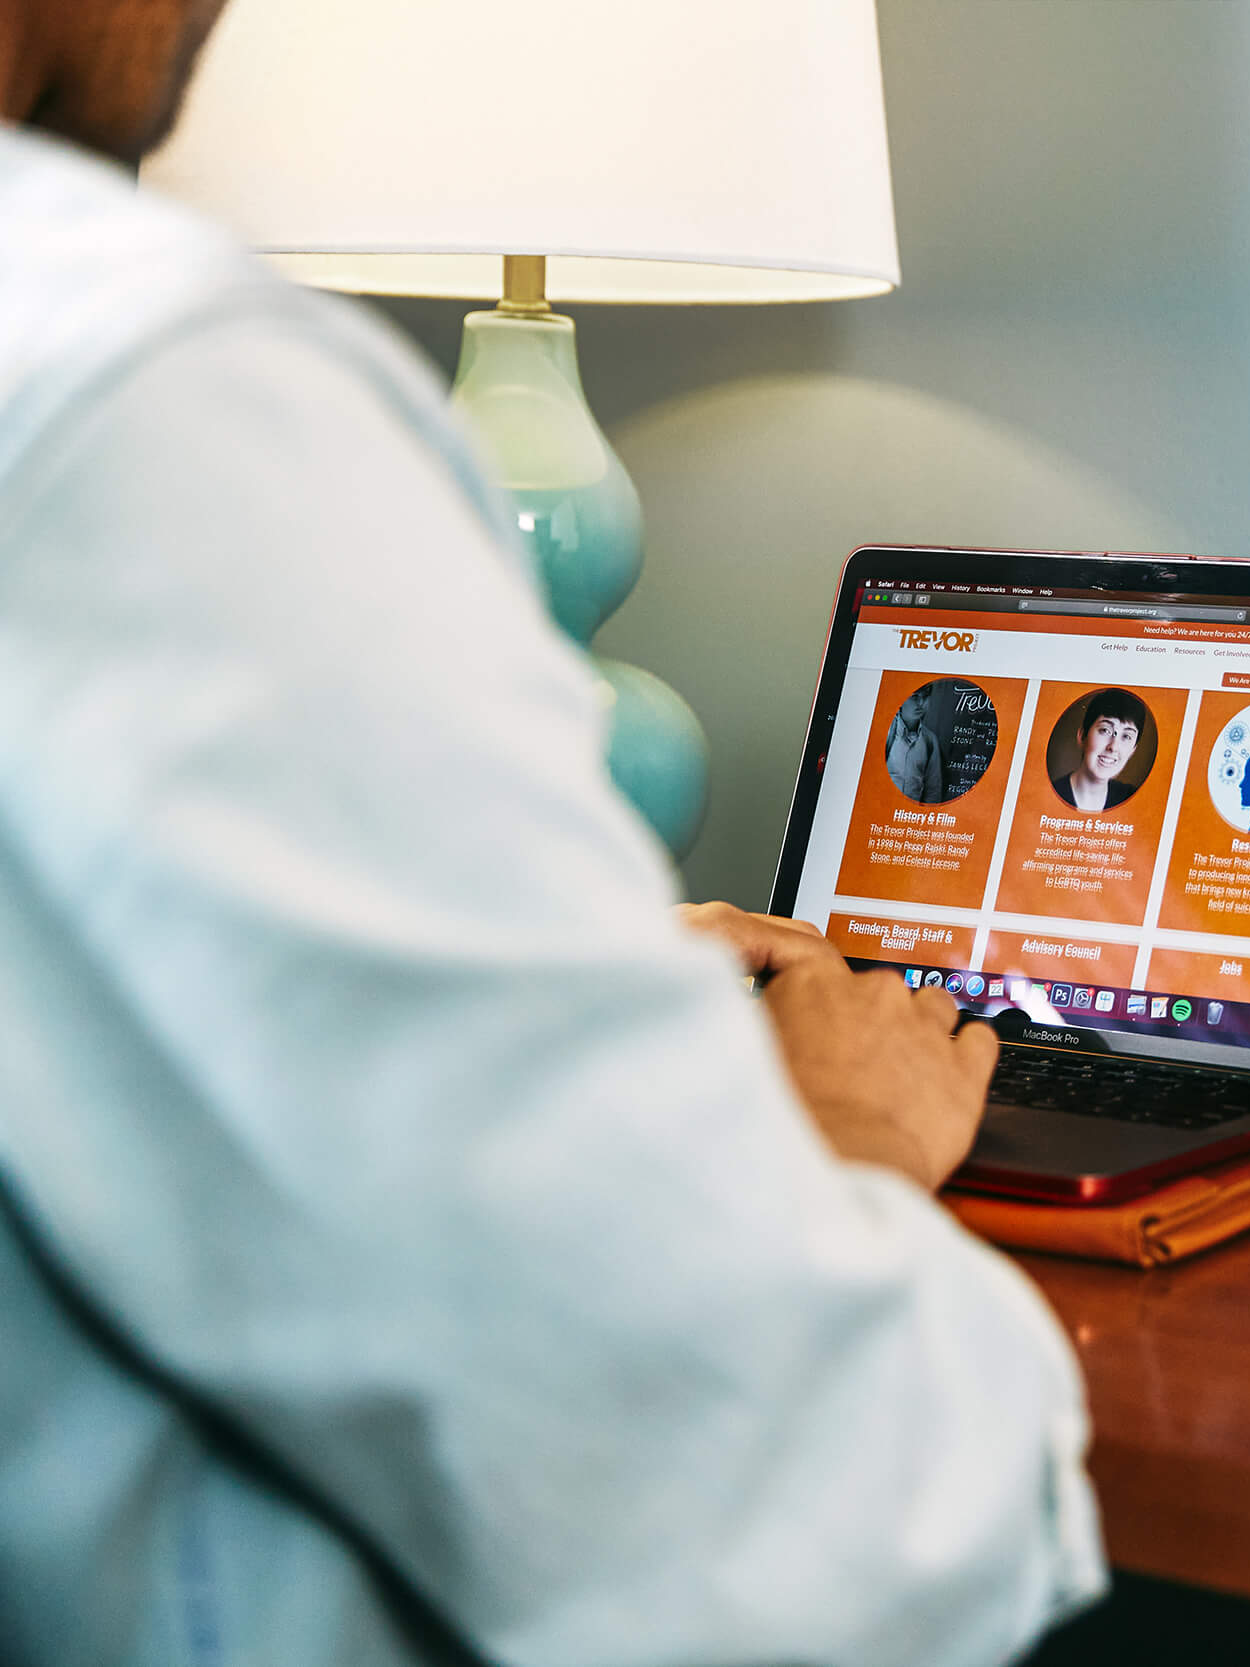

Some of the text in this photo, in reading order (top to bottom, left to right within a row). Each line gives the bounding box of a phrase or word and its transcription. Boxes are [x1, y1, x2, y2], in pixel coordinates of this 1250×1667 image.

[952, 584, 970, 593] History
[977, 586, 1006, 594] Bookmarks
[1012, 587, 1033, 595] Window
[1040, 588, 1053, 596] Help
[1143, 626, 1160, 634] Need
[1160, 626, 1177, 636] help?
[1178, 628, 1188, 636] We
[1199, 629, 1214, 637] here
[1215, 630, 1224, 638] for
[899, 629, 974, 652] TREVOR
[1101, 643, 1128, 652] Get Help
[1135, 645, 1166, 653] Education
[1174, 647, 1206, 656] Resources
[1213, 649, 1225, 657] Get
[893, 809, 956, 827] History & Film
[1040, 814, 1134, 836] Programs & Services
[870, 823, 975, 844] The Trevor Project was founded
[1040, 832, 1127, 851] The Trevor Project offers
[868, 837, 875, 848] in
[876, 838, 894, 851] 1998
[894, 839, 903, 851] by
[947, 844, 969, 858] Randy
[1034, 847, 1072, 860] accredited
[892, 854, 905, 866] and
[1193, 853, 1207, 866] The
[1209, 854, 1232, 867] Trevor
[1022, 860, 1134, 881] affirming programs and services
[1188, 868, 1197, 880] to
[1197, 869, 1235, 885] producing
[1045, 876, 1054, 888] to
[1054, 877, 1080, 891] LGBTQ
[1185, 882, 1201, 895] that
[1201, 883, 1225, 899] brings
[1226, 886, 1242, 899] new
[1208, 899, 1225, 912] field
[1225, 900, 1234, 912] of
[847, 919, 890, 938] Founders,
[921, 927, 945, 943] Staff
[945, 930, 953, 944] &
[881, 935, 915, 951] Council
[1021, 938, 1102, 961] Advisory Council
[1219, 960, 1243, 976] Jobs
[991, 985, 1001, 994] 22
[1055, 989, 1067, 1002] Ps
[1022, 1029, 1080, 1045] MacBook Pro
